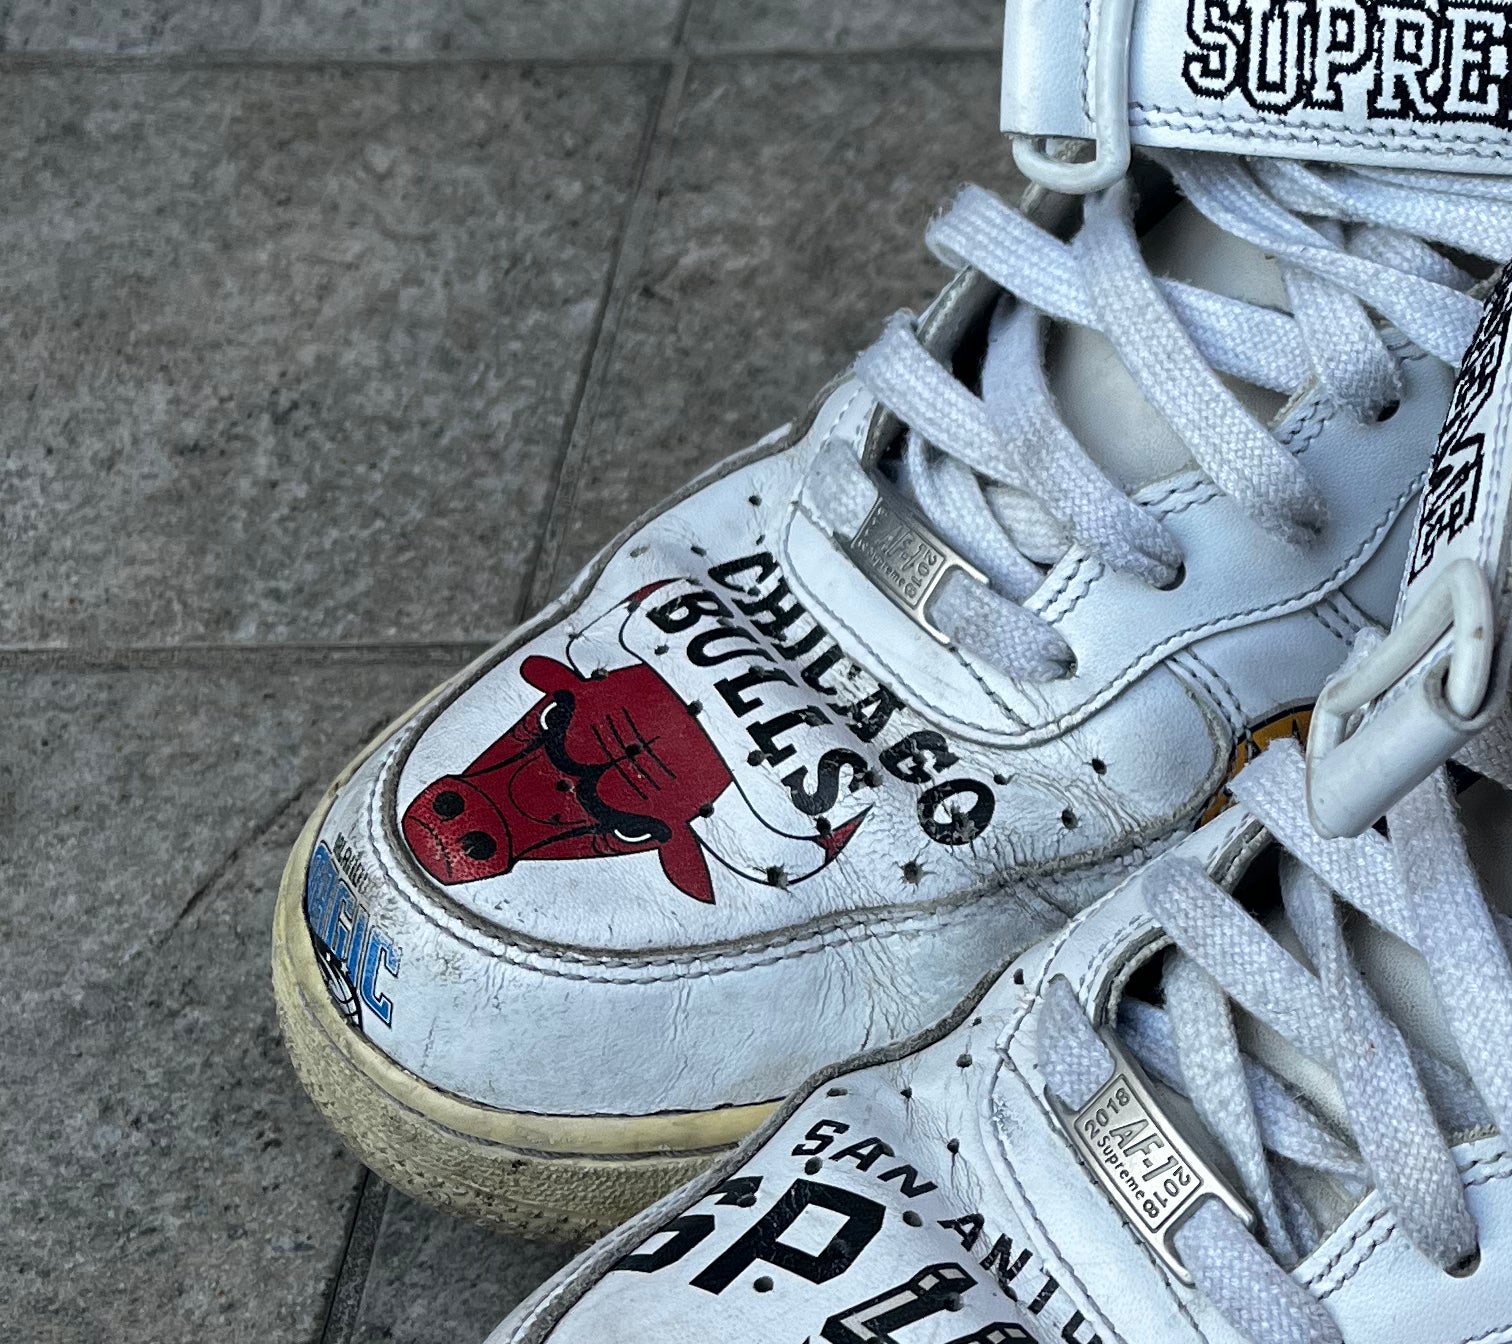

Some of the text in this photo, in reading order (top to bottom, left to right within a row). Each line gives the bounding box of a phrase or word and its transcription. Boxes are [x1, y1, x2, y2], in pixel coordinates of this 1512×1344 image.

[645, 592, 872, 816] BULLS
[706, 551, 996, 846] CHICAGO
[307, 840, 402, 1030] GIC
[1084, 1086, 1131, 1140] 2018
[791, 1118, 939, 1199] SAN
[1096, 1135, 1146, 1201] Supreme
[1108, 1118, 1180, 1183] AF-1
[1142, 1165, 1192, 1219] 2018
